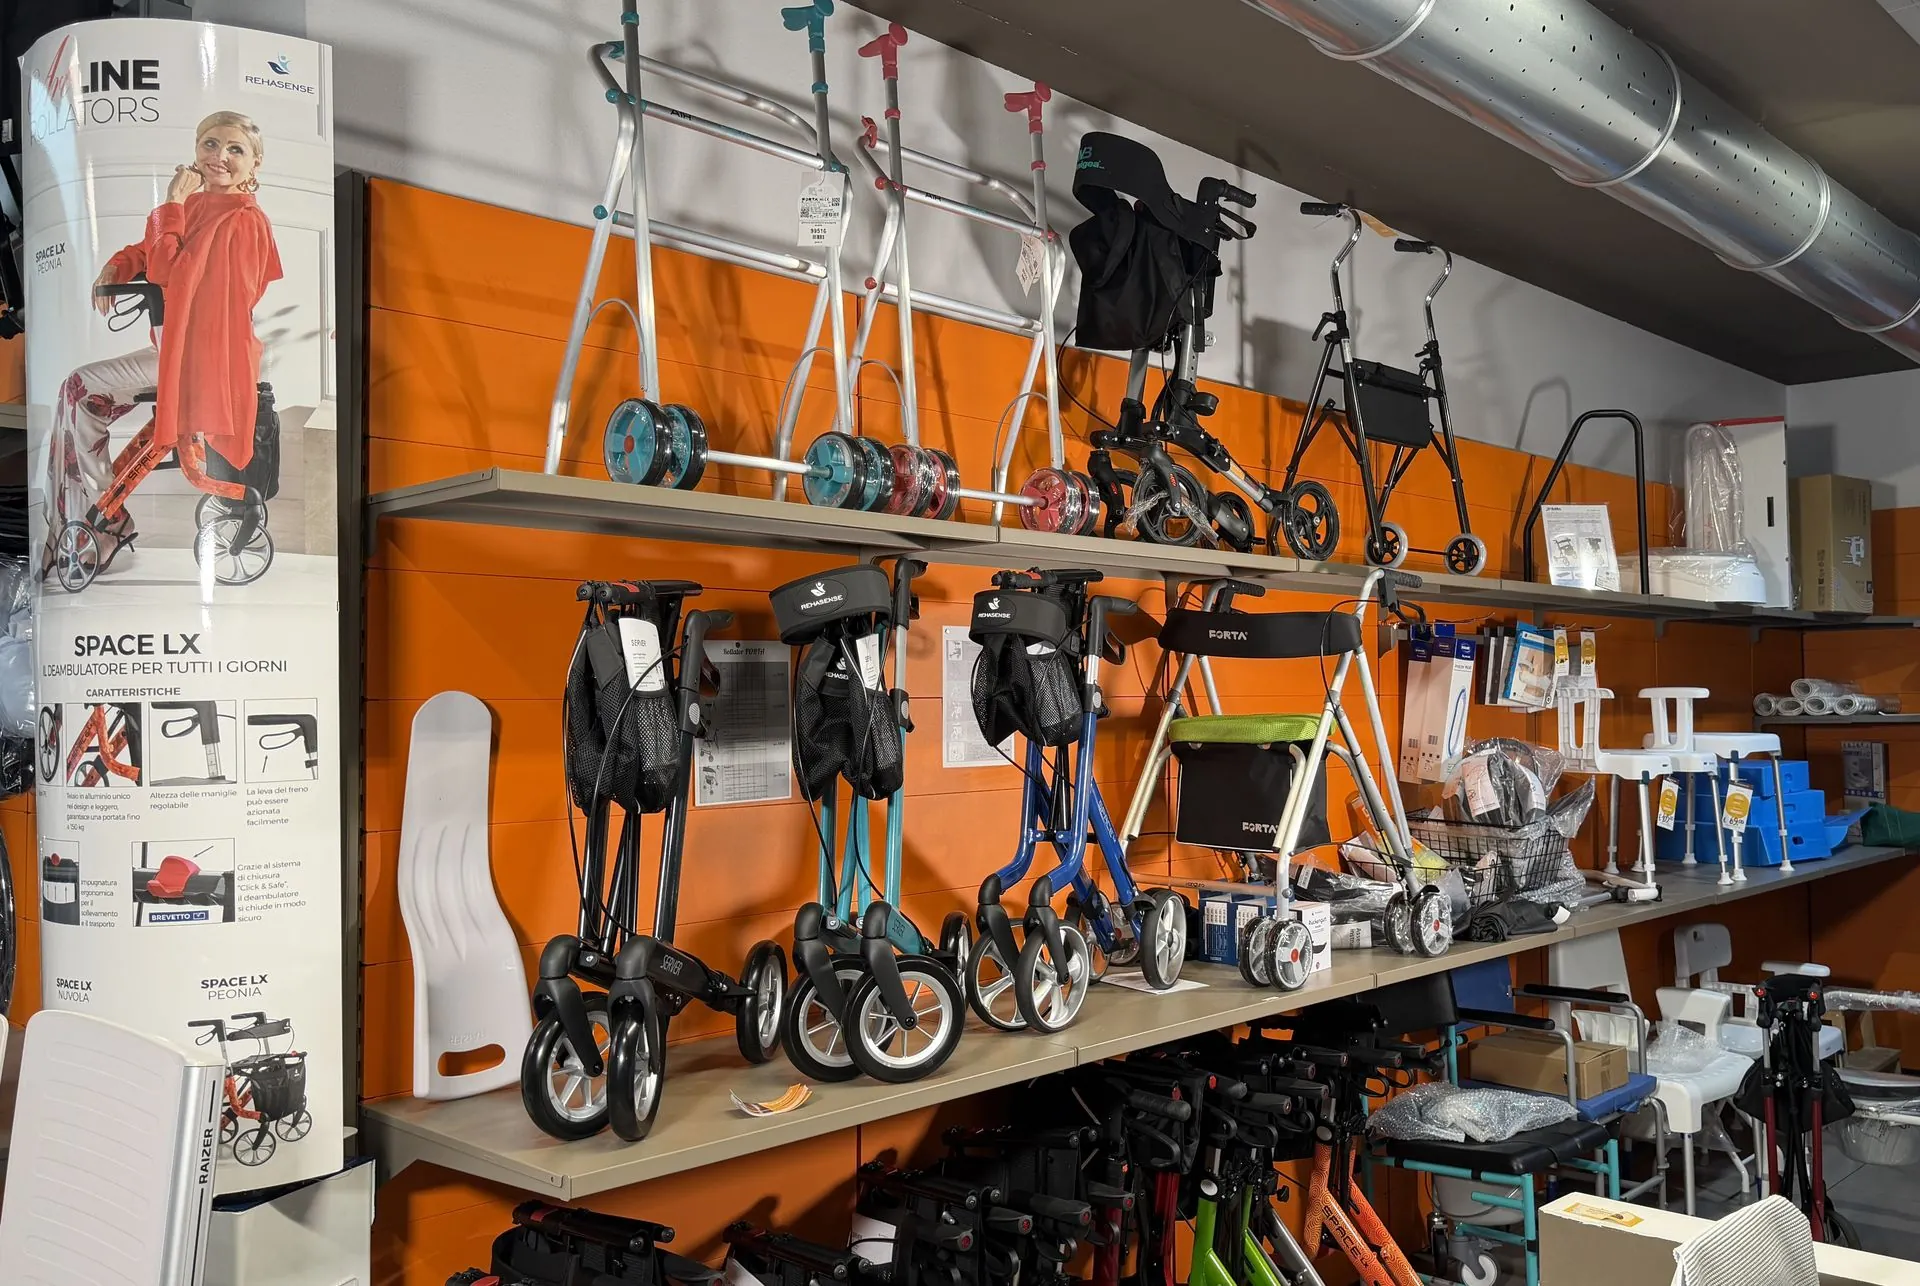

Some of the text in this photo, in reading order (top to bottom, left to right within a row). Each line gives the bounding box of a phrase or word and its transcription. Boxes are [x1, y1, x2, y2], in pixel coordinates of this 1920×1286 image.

[245, 75, 315, 95] REHASENSE
[35, 242, 66, 263] SPACE LX
[38, 257, 62, 276] PEONIA
[800, 594, 844, 611] REHASENSE
[1208, 629, 1248, 641] FORTA
[74, 633, 201, 656] SPACE LX
[48, 662, 127, 677] DEAMBULATORE
[132, 662, 163, 674] PER
[167, 660, 213, 673] TUTTI
[218, 660, 222, 673] I
[226, 660, 287, 673] GIORNI
[86, 687, 181, 697] CARATTERISTICHE
[112, 792, 131, 800] unico
[180, 790, 199, 798] delle
[201, 789, 237, 799] maniglie
[150, 802, 189, 810] regolabile
[246, 798, 262, 806] può
[102, 813, 125, 821] portata
[126, 812, 140, 820] fino
[246, 808, 281, 816] azionata
[246, 817, 289, 826] facilmente
[1242, 821, 1279, 834] FORTA
[237, 863, 262, 871] Grazie
[272, 860, 301, 868] sistema
[237, 872, 280, 881] di chiusura
[243, 891, 299, 901] deambulatore
[245, 903, 273, 912] chiude
[274, 901, 282, 909] in
[283, 900, 306, 908] modo
[151, 913, 191, 922] BREVETTO
[238, 914, 262, 922] sicuro
[660, 954, 683, 976] SERVER
[56, 978, 92, 991] SPACE LX
[201, 974, 268, 989] SPACE LX
[58, 990, 89, 1003] NUVOLA
[208, 986, 262, 1000] PEONIA
[198, 1127, 214, 1185] RAIZER
[1321, 1205, 1361, 1260] SPACE
